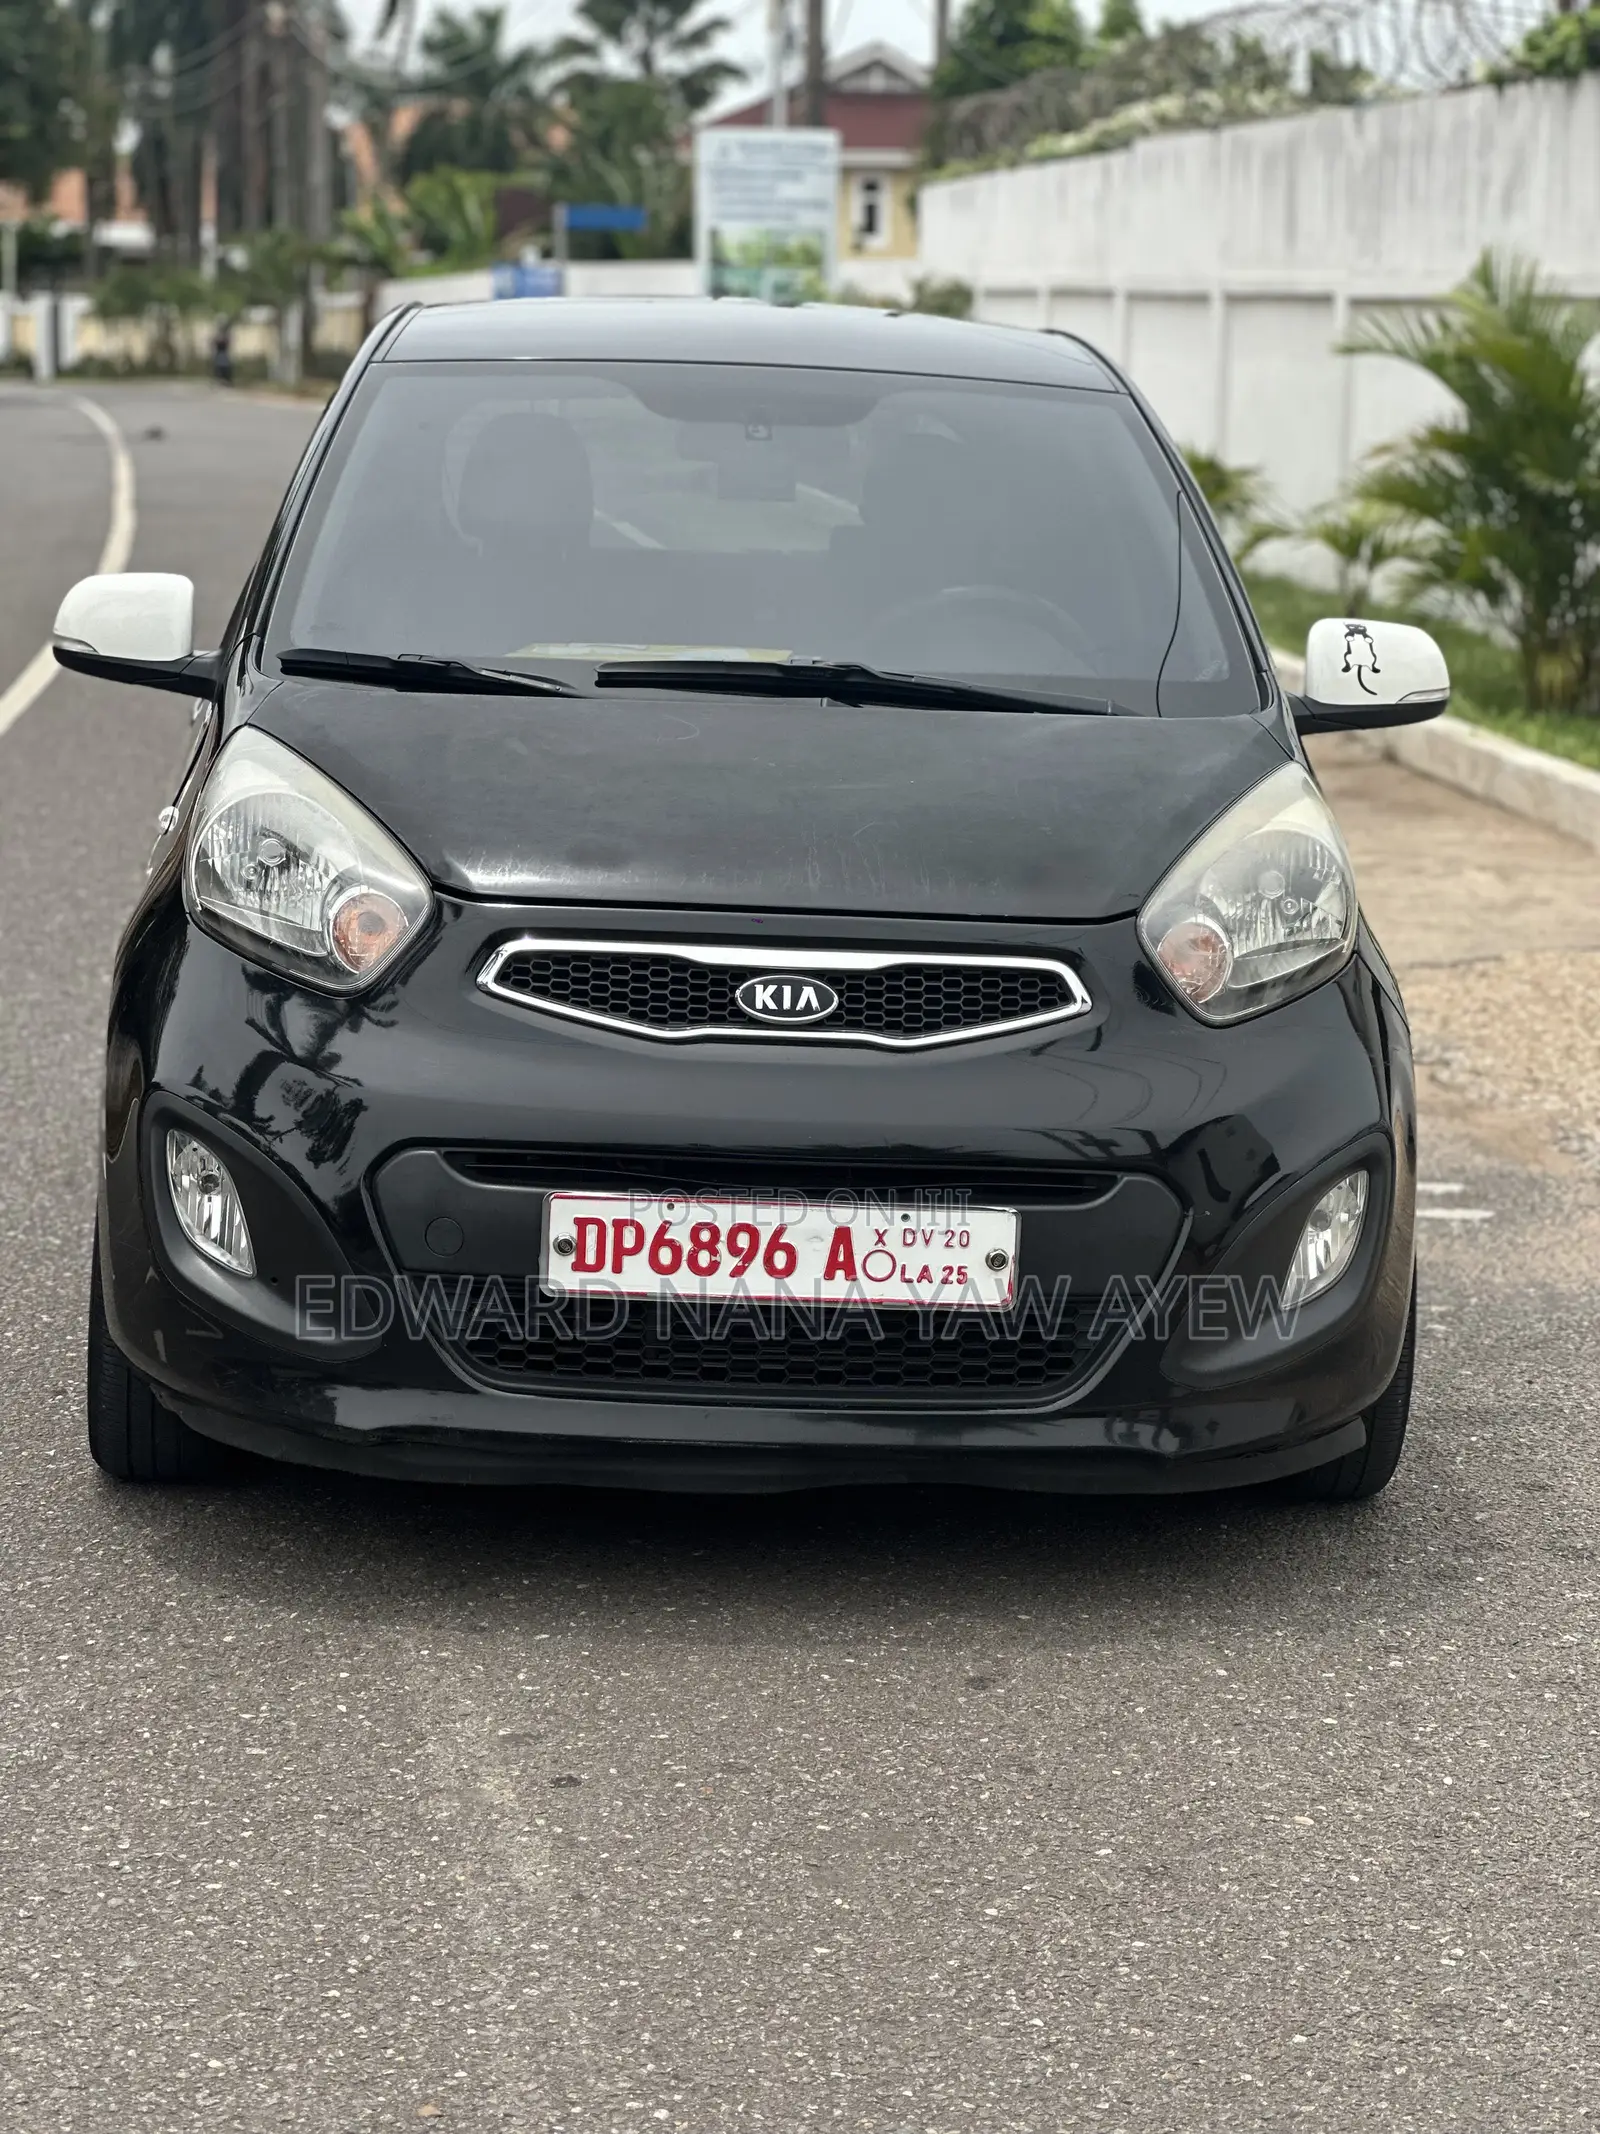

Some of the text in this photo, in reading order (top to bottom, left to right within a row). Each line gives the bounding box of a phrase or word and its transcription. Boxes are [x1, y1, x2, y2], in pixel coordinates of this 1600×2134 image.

[753, 983, 821, 1012] KIA
[571, 1216, 858, 1281] DP6896 A
[874, 1228, 971, 1248] X DV 20
[900, 1264, 968, 1285] LA 25
